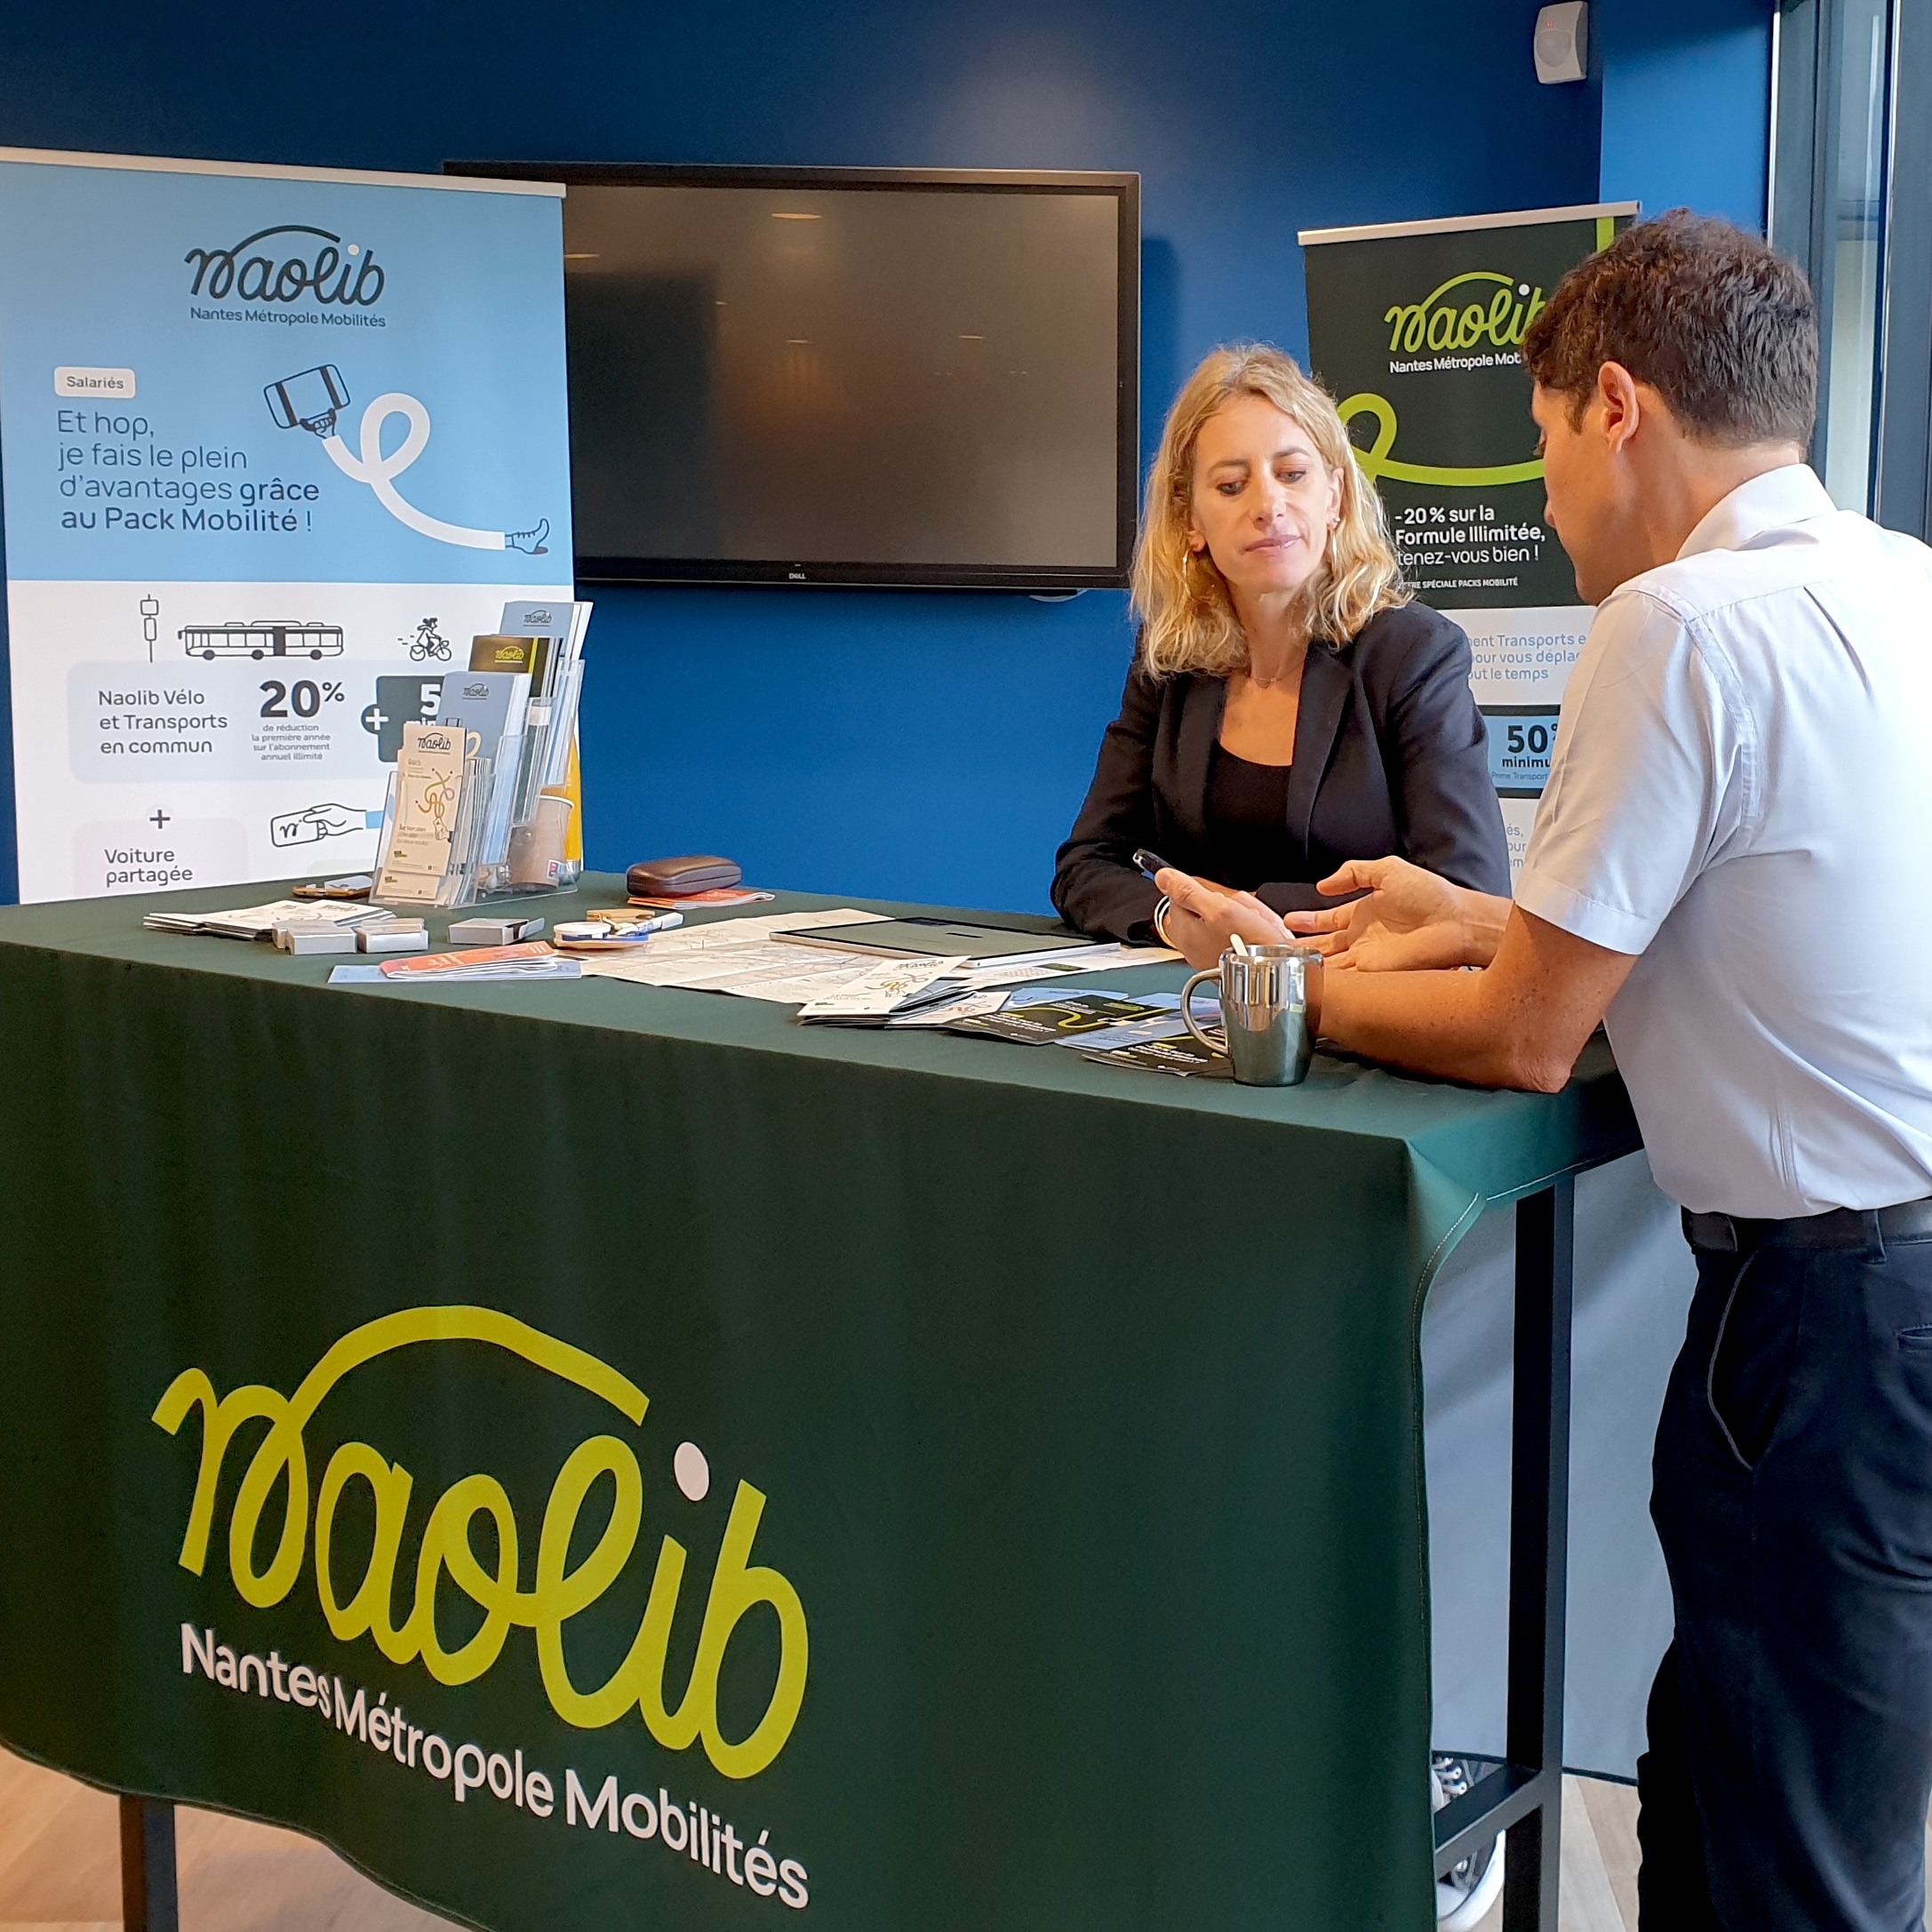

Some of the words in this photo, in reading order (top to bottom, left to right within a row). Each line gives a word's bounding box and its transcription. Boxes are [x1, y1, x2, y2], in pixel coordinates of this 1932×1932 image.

[190, 307, 243, 321] Nantes
[244, 309, 319, 326] Métropole
[321, 314, 386, 328] Mobilités
[1389, 360, 1433, 374] Nantes
[1433, 355, 1493, 371] Métropole
[66, 375, 124, 390] Salariés
[58, 410, 87, 434] Et
[94, 411, 155, 441] hop,
[58, 443, 84, 472] je
[92, 443, 142, 467] fais
[149, 444, 173, 467] le
[181, 446, 248, 474] plein
[240, 477, 320, 507] grâce
[61, 511, 96, 529] au
[105, 507, 175, 530] Pack
[181, 508, 298, 531] Mobilité
[1449, 508, 1477, 523] sur
[1479, 504, 1495, 522] la
[1395, 526, 1466, 546] Formule
[1469, 522, 1546, 543] Illimitée,
[1397, 549, 1490, 565] tenez-vous
[1492, 546, 1530, 563] bien
[1422, 579, 1457, 588] SPÉCIALE
[1457, 579, 1481, 587] PACKS
[1482, 577, 1519, 587] MOBILITÉ
[1469, 635, 1495, 647] ent
[1497, 634, 1575, 650] Transports
[1472, 653, 1497, 664] our
[1499, 653, 1533, 664] vous
[1490, 667, 1502, 680] le
[1505, 667, 1549, 683] temps
[99, 690, 160, 707] Naolib
[164, 688, 205, 706] Vélo
[100, 715, 120, 730] et
[123, 714, 228, 734] Transports
[100, 741, 124, 754] en
[129, 740, 213, 754] commun
[261, 733, 302, 743] première
[293, 752, 323, 761] illimité
[104, 848, 175, 865] Voiture
[106, 865, 194, 888] partagée
[180, 1622, 332, 1720] Nantes
[333, 1675, 555, 1819] Métropole
[564, 1768, 810, 1911] Mobilités
